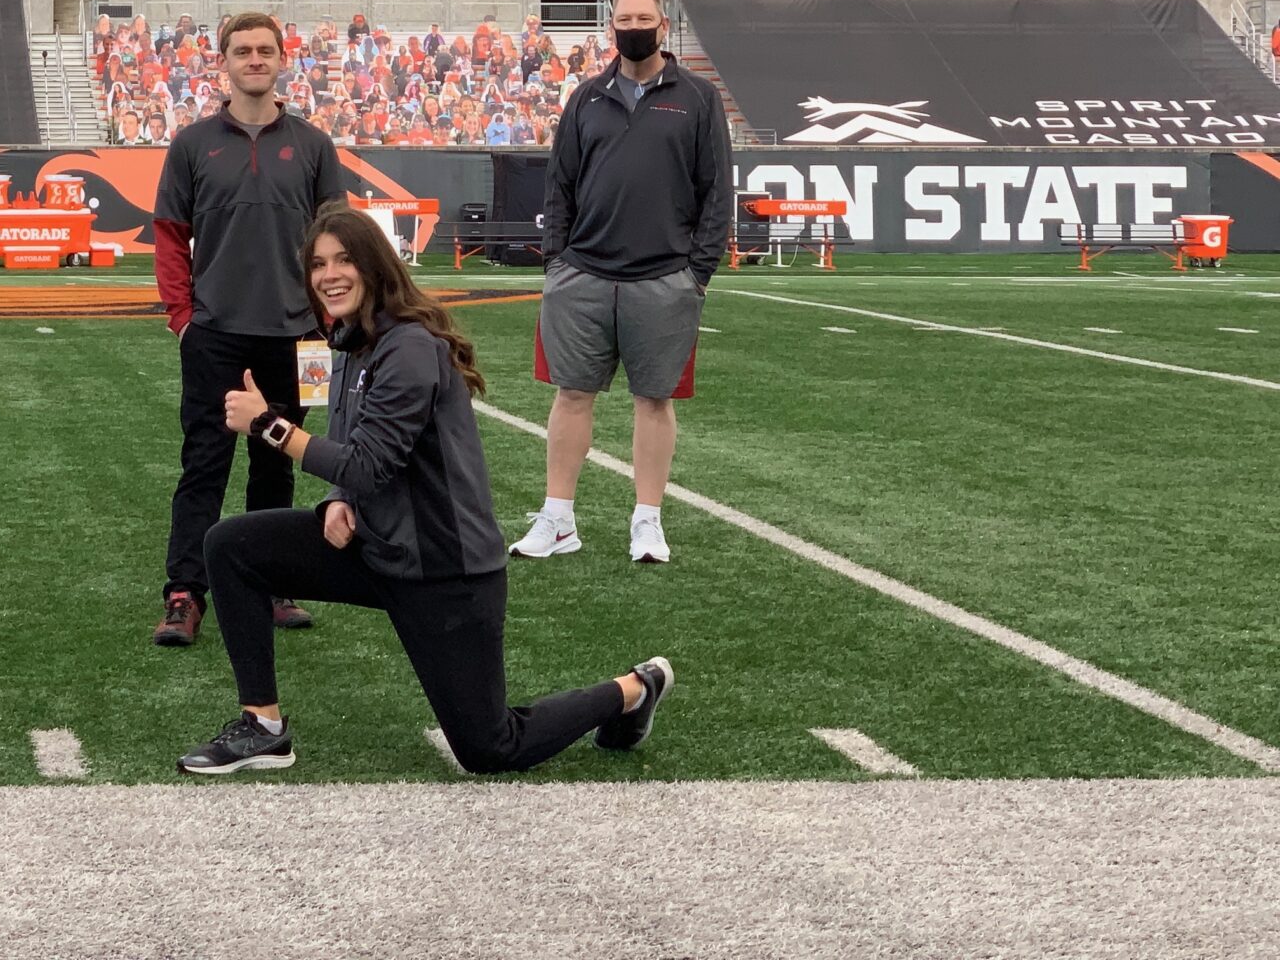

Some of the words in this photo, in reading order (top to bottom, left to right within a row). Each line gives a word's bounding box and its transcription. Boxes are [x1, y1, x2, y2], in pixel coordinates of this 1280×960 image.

[1035, 100, 1217, 113] SPIRIT
[988, 113, 1280, 129] MOUNTAIN
[1044, 132, 1266, 145] CASINO
[371, 202, 419, 211] GATORADE
[779, 202, 829, 211] GATORADE
[904, 166, 1187, 241] STATE
[1203, 226, 1221, 247] G
[14, 255, 52, 263] GATORADE
